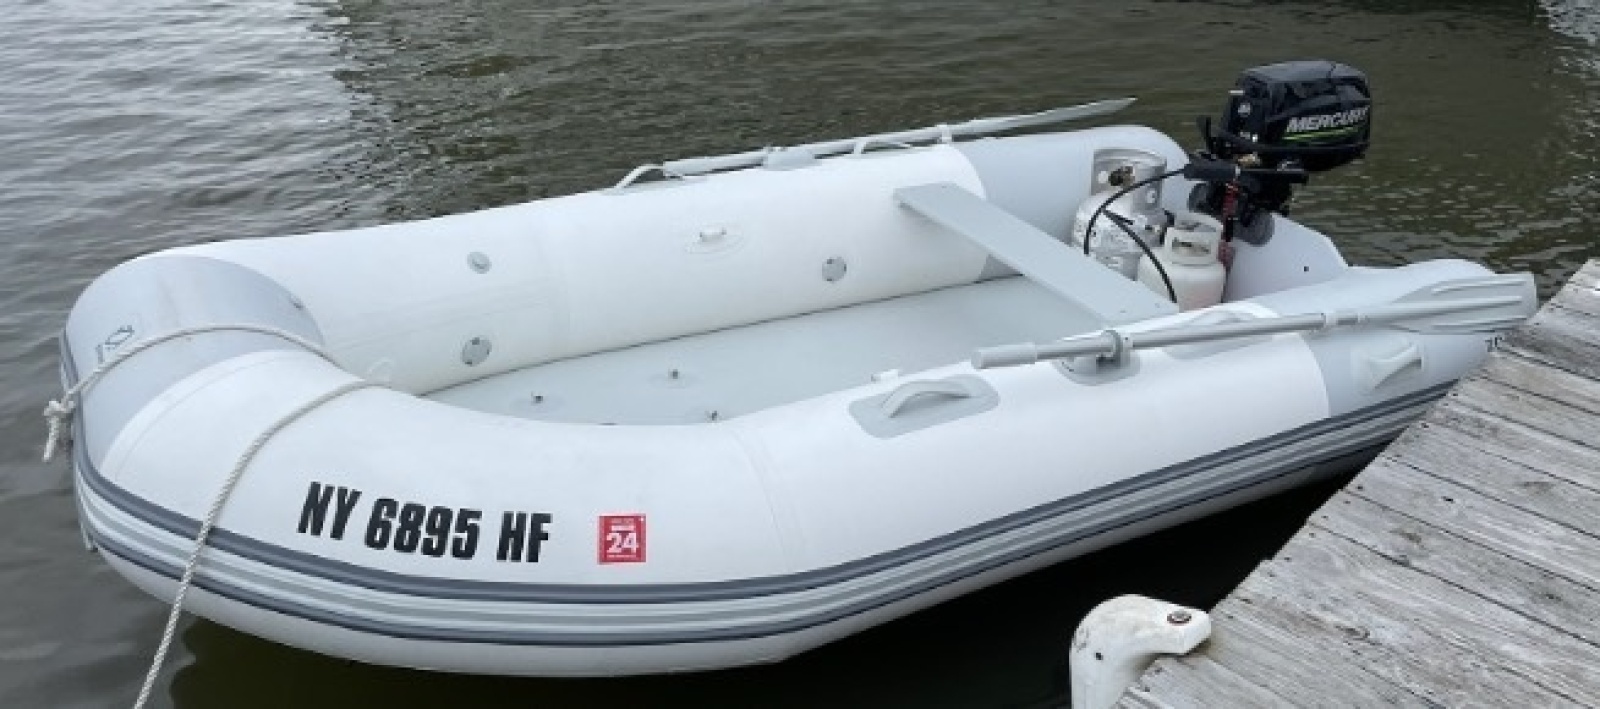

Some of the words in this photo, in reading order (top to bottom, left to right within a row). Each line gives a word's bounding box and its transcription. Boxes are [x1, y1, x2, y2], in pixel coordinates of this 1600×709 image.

[1286, 105, 1370, 132] MERCURY
[297, 481, 362, 540] NY
[364, 498, 482, 560] 6895
[496, 511, 552, 563] HF
[606, 532, 640, 553] 24
